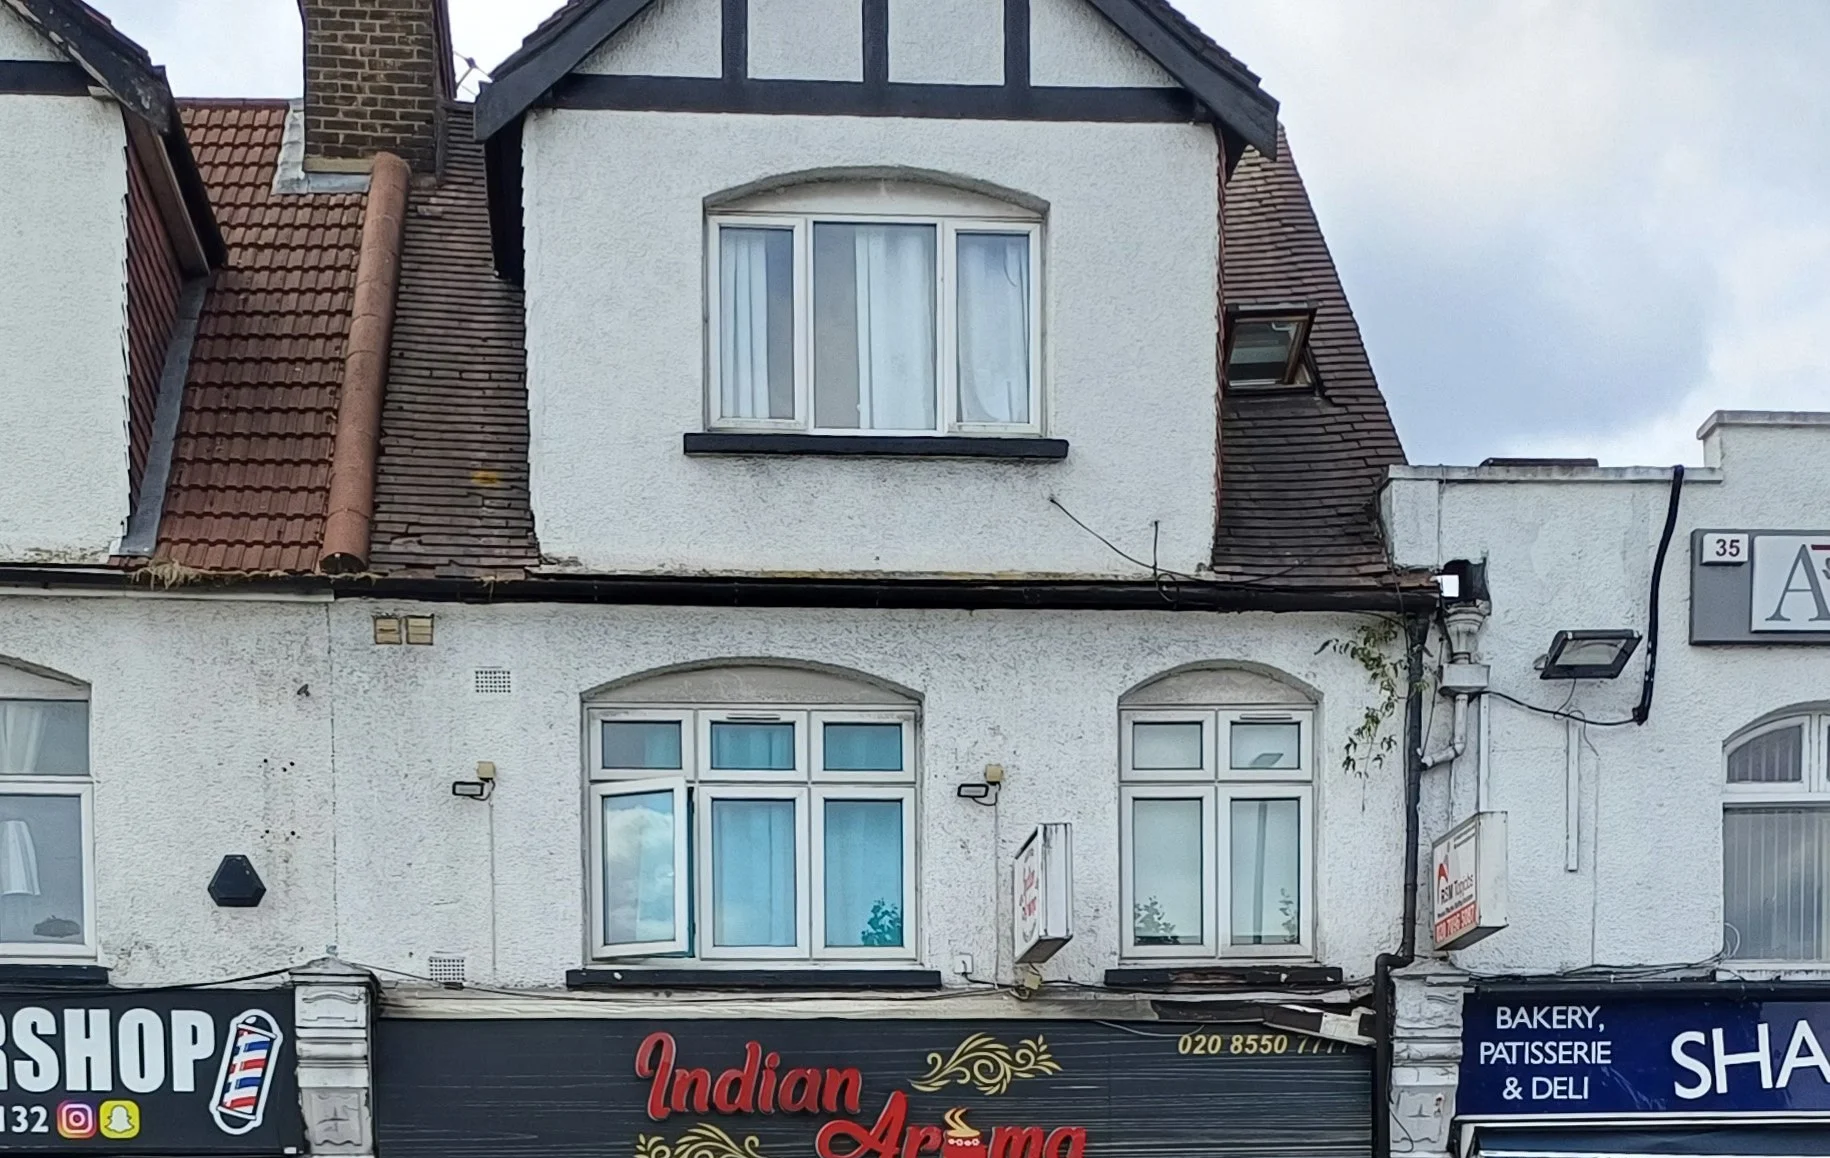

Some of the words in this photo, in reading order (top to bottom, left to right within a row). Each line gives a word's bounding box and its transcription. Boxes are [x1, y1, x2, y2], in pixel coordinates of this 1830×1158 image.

[1715, 539, 1741, 557] 35
[1495, 1005, 1605, 1033] BAKERY,
[0, 1006, 216, 1093] SHOP
[1178, 1034, 1222, 1055] 020
[1229, 1034, 1288, 1055] 8550
[1479, 1040, 1612, 1065] PATISSERIE
[635, 1031, 862, 1122] Indian
[1502, 1077, 1523, 1100] &
[1531, 1076, 1589, 1100] DELI
